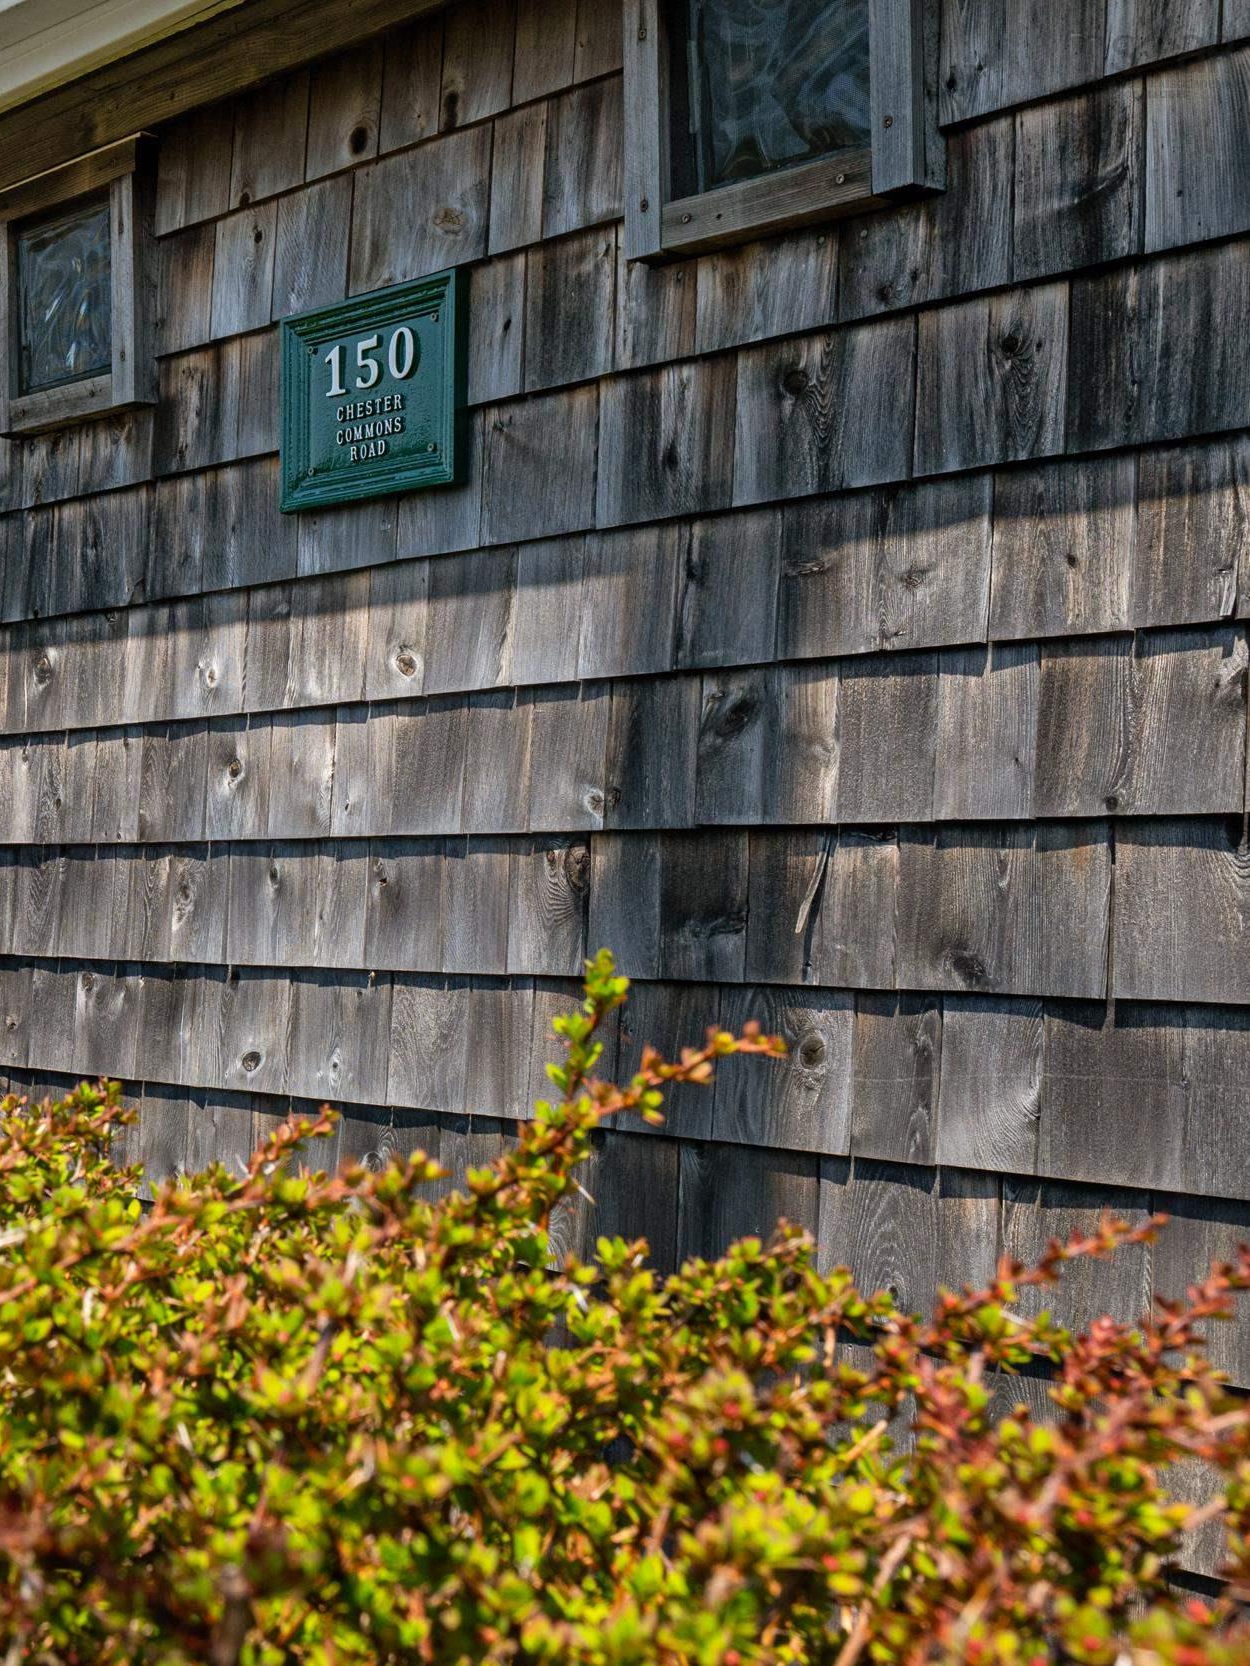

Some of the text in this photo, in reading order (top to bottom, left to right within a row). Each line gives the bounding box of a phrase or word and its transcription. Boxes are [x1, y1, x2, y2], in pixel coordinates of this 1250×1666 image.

[324, 326, 415, 397] 150
[336, 394, 402, 422] CHESTER
[336, 417, 402, 445] COMMONS
[350, 440, 386, 462] ROAD
